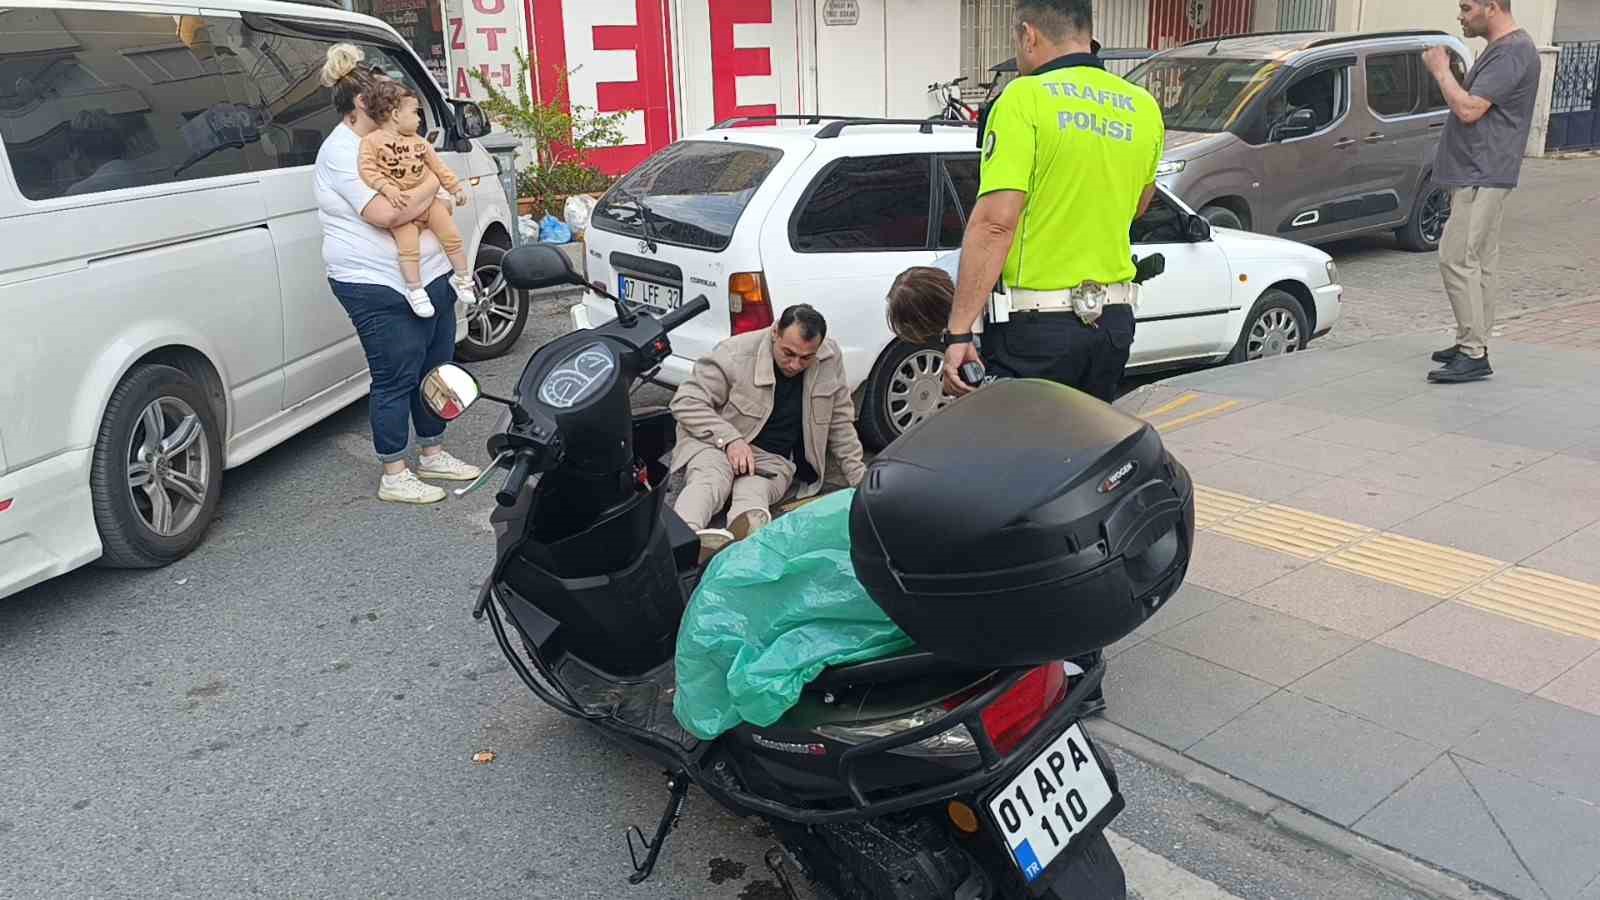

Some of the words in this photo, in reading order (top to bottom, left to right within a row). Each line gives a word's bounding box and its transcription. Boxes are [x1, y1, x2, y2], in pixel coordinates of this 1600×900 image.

[624, 280, 635, 299] 07
[643, 284, 660, 305] LFF
[998, 785, 1034, 834] 01
[1033, 736, 1089, 804] APA
[1041, 788, 1089, 848] 110
[1025, 862, 1041, 878] TR
